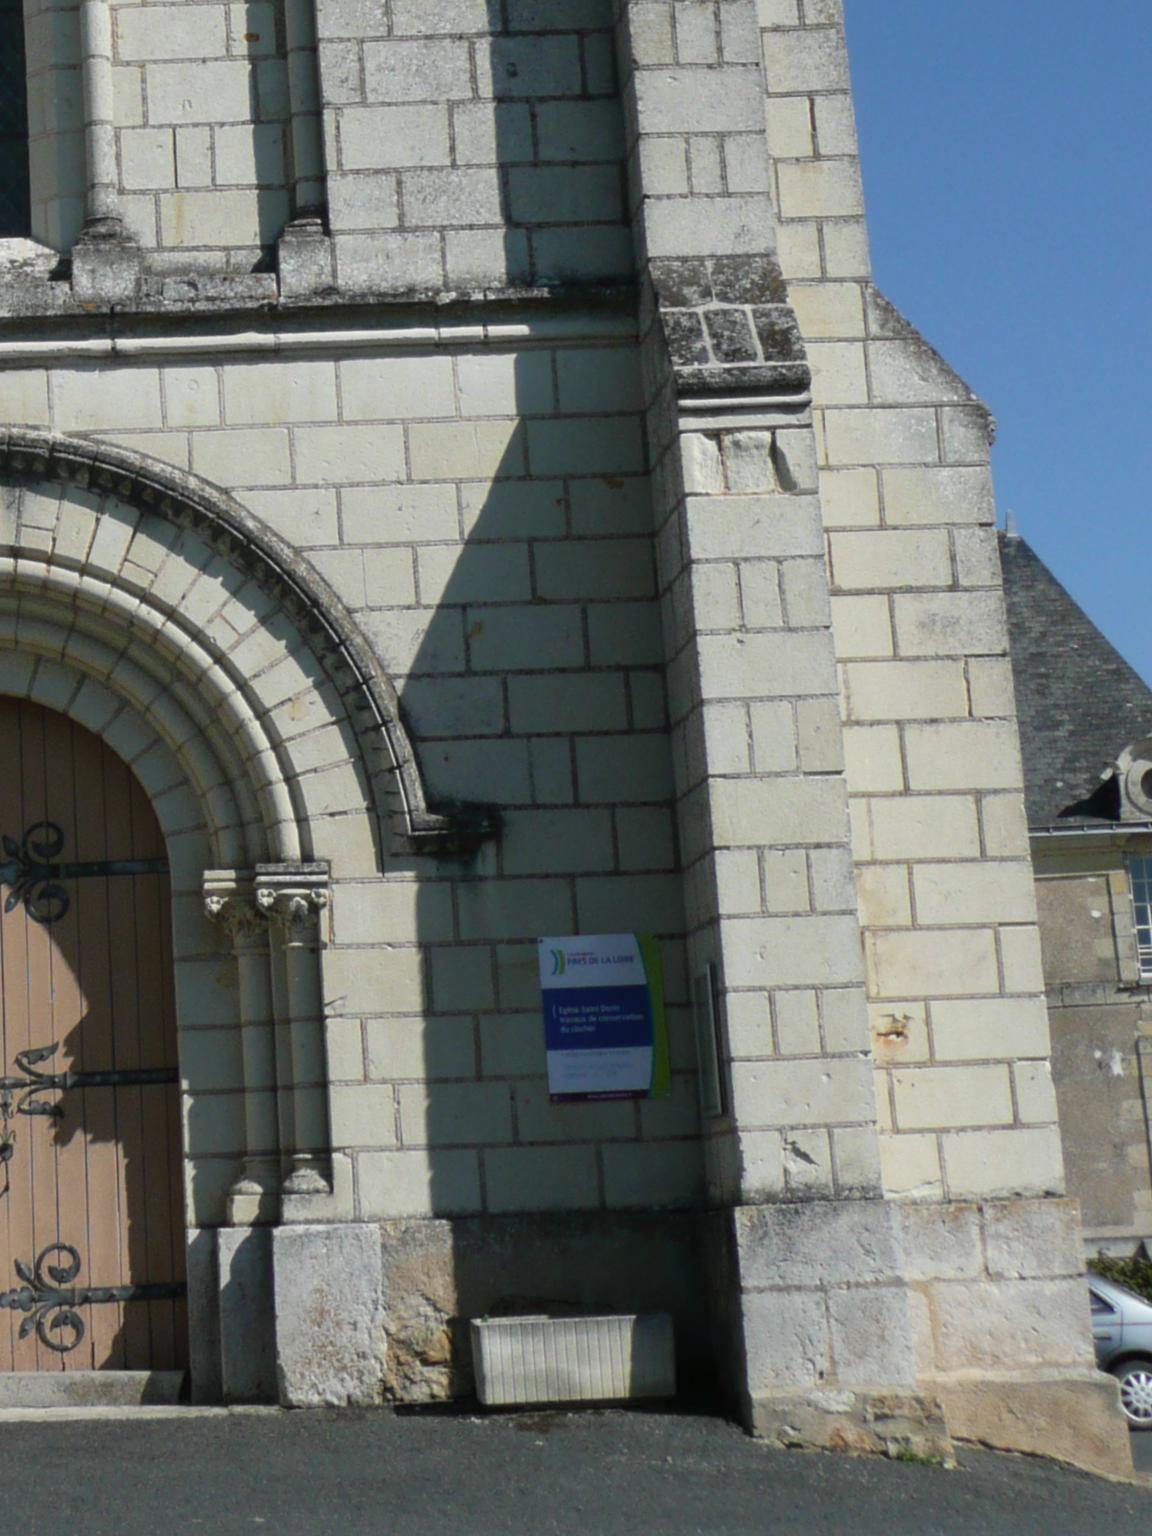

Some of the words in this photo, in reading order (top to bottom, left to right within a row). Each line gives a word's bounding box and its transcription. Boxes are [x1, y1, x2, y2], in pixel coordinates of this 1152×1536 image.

[567, 957, 587, 965] PAYS
[589, 957, 599, 965] DE
[601, 956, 612, 964] LA
[612, 955, 634, 963] LOIRE
